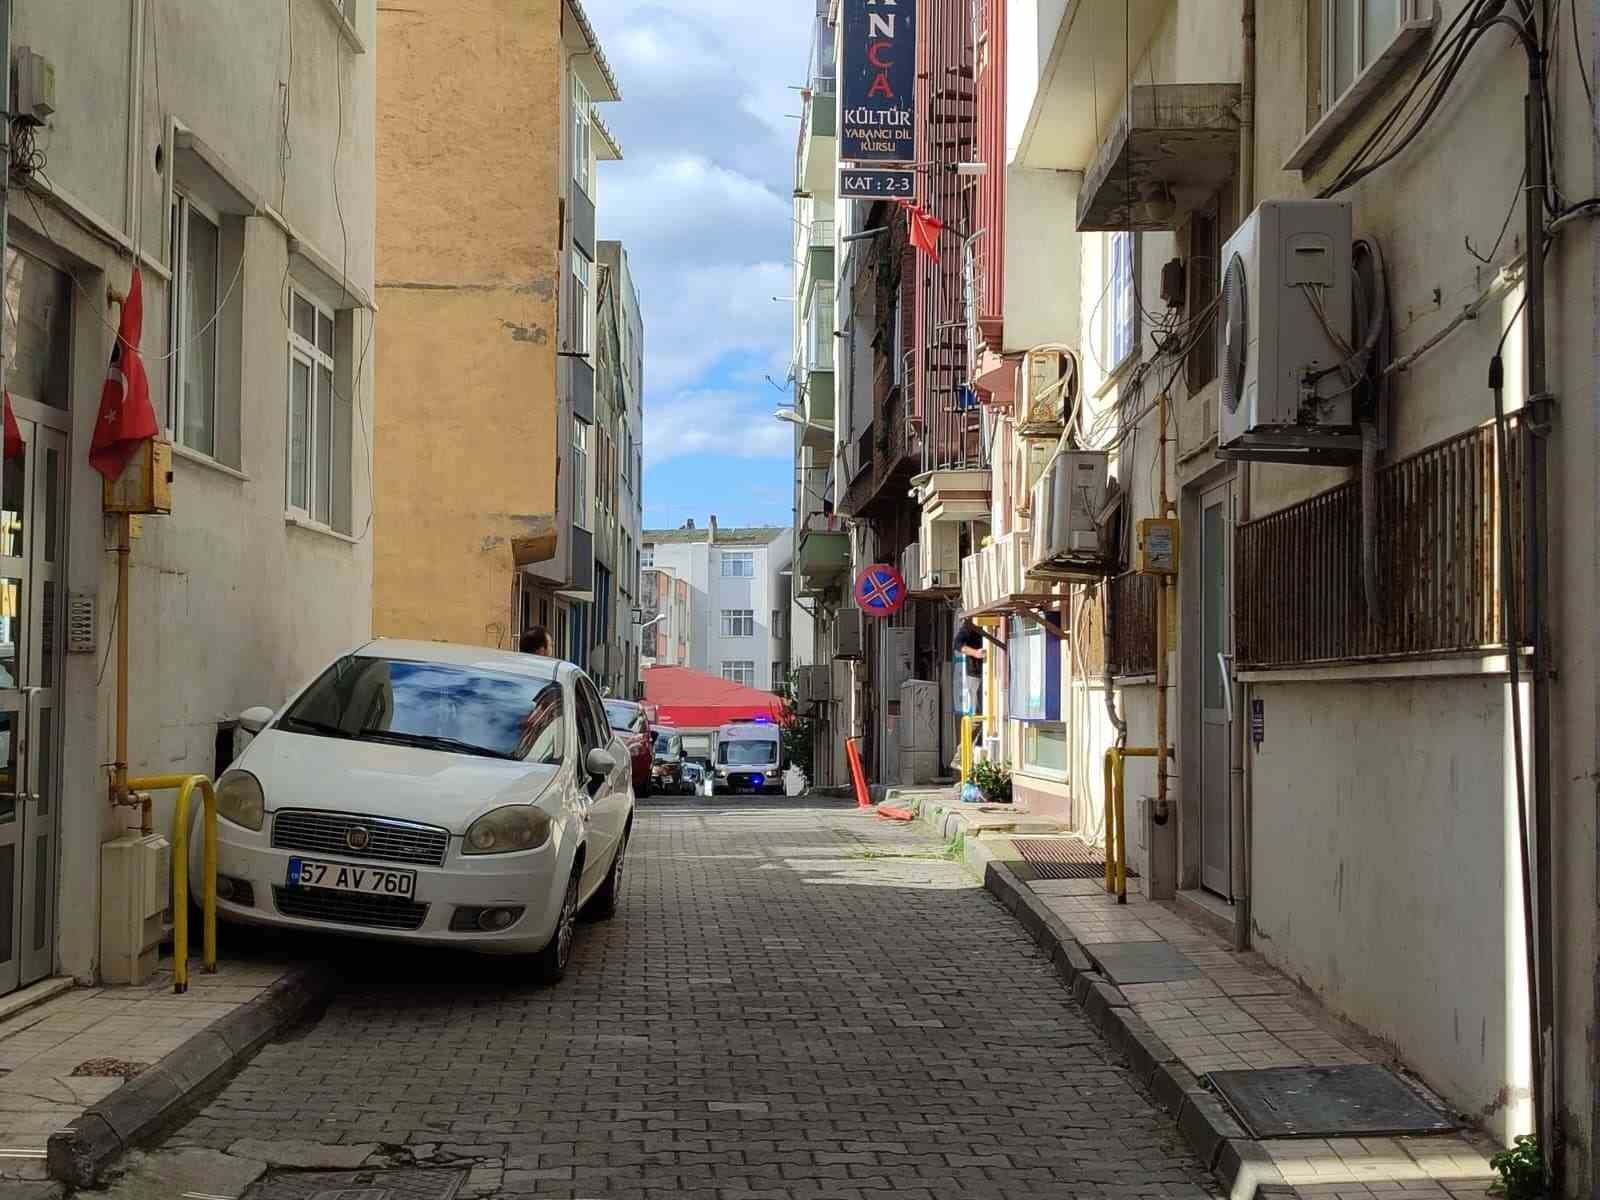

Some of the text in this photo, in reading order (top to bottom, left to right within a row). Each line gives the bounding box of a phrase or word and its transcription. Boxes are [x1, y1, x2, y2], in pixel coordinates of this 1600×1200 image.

[867, 0, 896, 98] NCA
[844, 106, 911, 126] KÜLTÜR
[845, 129, 912, 139] YABANCI DİL
[861, 142, 896, 152] KURSU
[844, 176, 873, 190] KAT
[886, 177, 910, 190] 2-3
[301, 863, 412, 894] 57 AV 760
